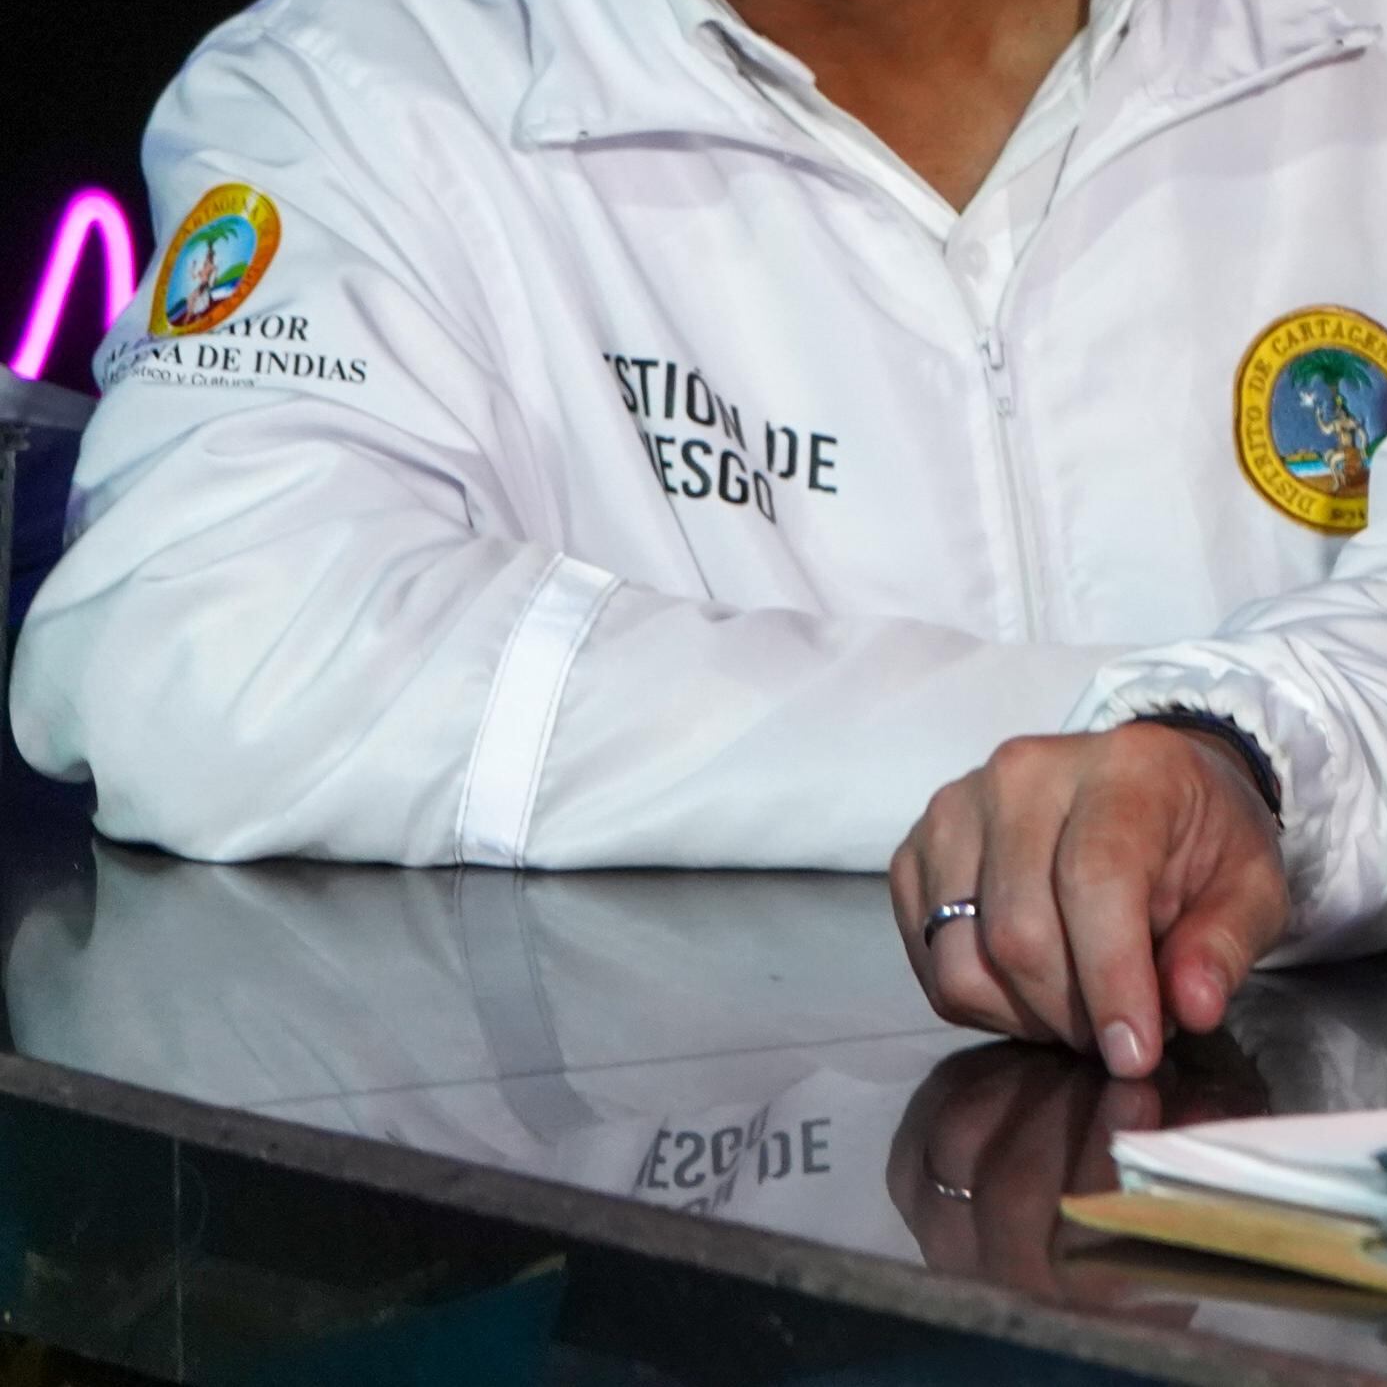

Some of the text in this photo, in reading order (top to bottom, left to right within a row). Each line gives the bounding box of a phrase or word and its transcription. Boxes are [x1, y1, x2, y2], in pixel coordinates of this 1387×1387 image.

[197, 344, 242, 373] DE
[254, 354, 369, 385] INDIAS
[765, 420, 838, 494] DE
